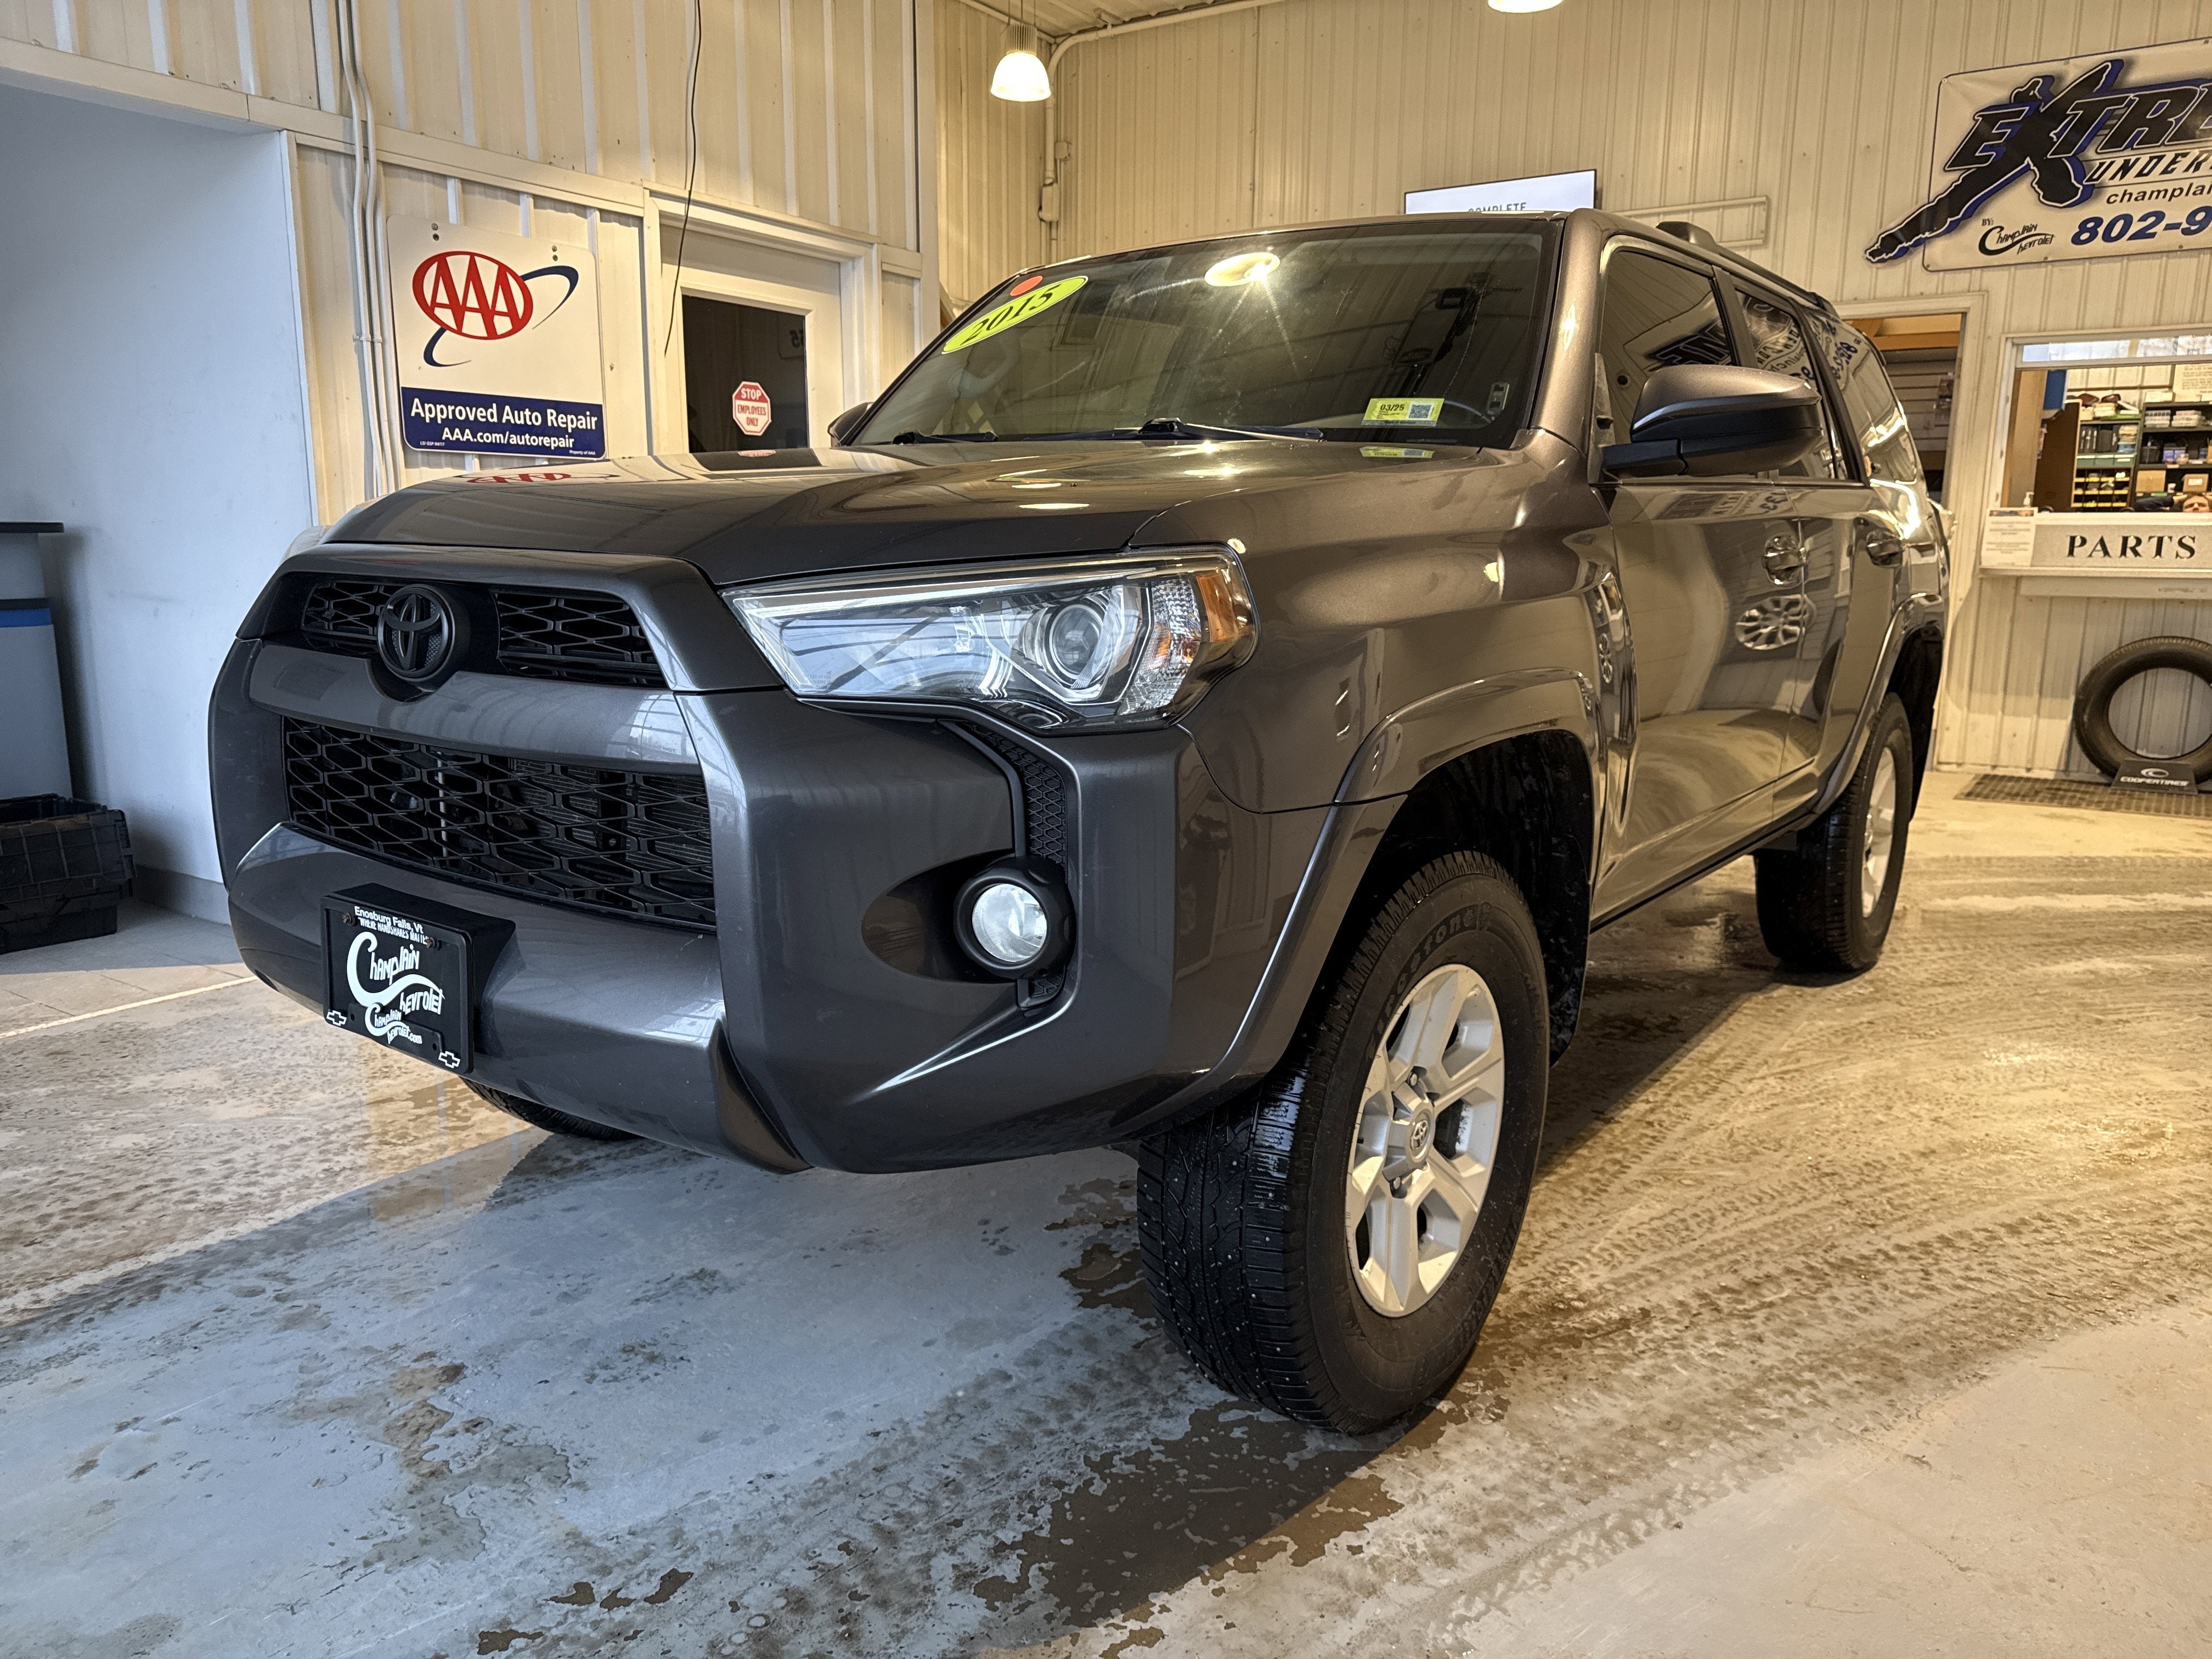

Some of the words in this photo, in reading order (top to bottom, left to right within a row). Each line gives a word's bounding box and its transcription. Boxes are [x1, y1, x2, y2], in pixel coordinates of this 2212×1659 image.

[2071, 206, 2212, 245] 802-9
[426, 253, 527, 338] AAA
[960, 283, 1062, 346] 2015
[741, 388, 761, 400] STOP
[411, 398, 498, 424] Approved
[502, 405, 541, 425] Auto
[547, 409, 597, 432] Repair
[737, 404, 766, 416] EMPLOYEES
[746, 417, 758, 426] ONLY
[442, 427, 574, 449] AAA.com/autorepair
[2067, 535, 2196, 560] PARTS
[354, 906, 391, 926] Enosburg
[393, 916, 414, 933] Falls,
[414, 922, 424, 934] Vt
[377, 922, 409, 939] HANDSHAKES
